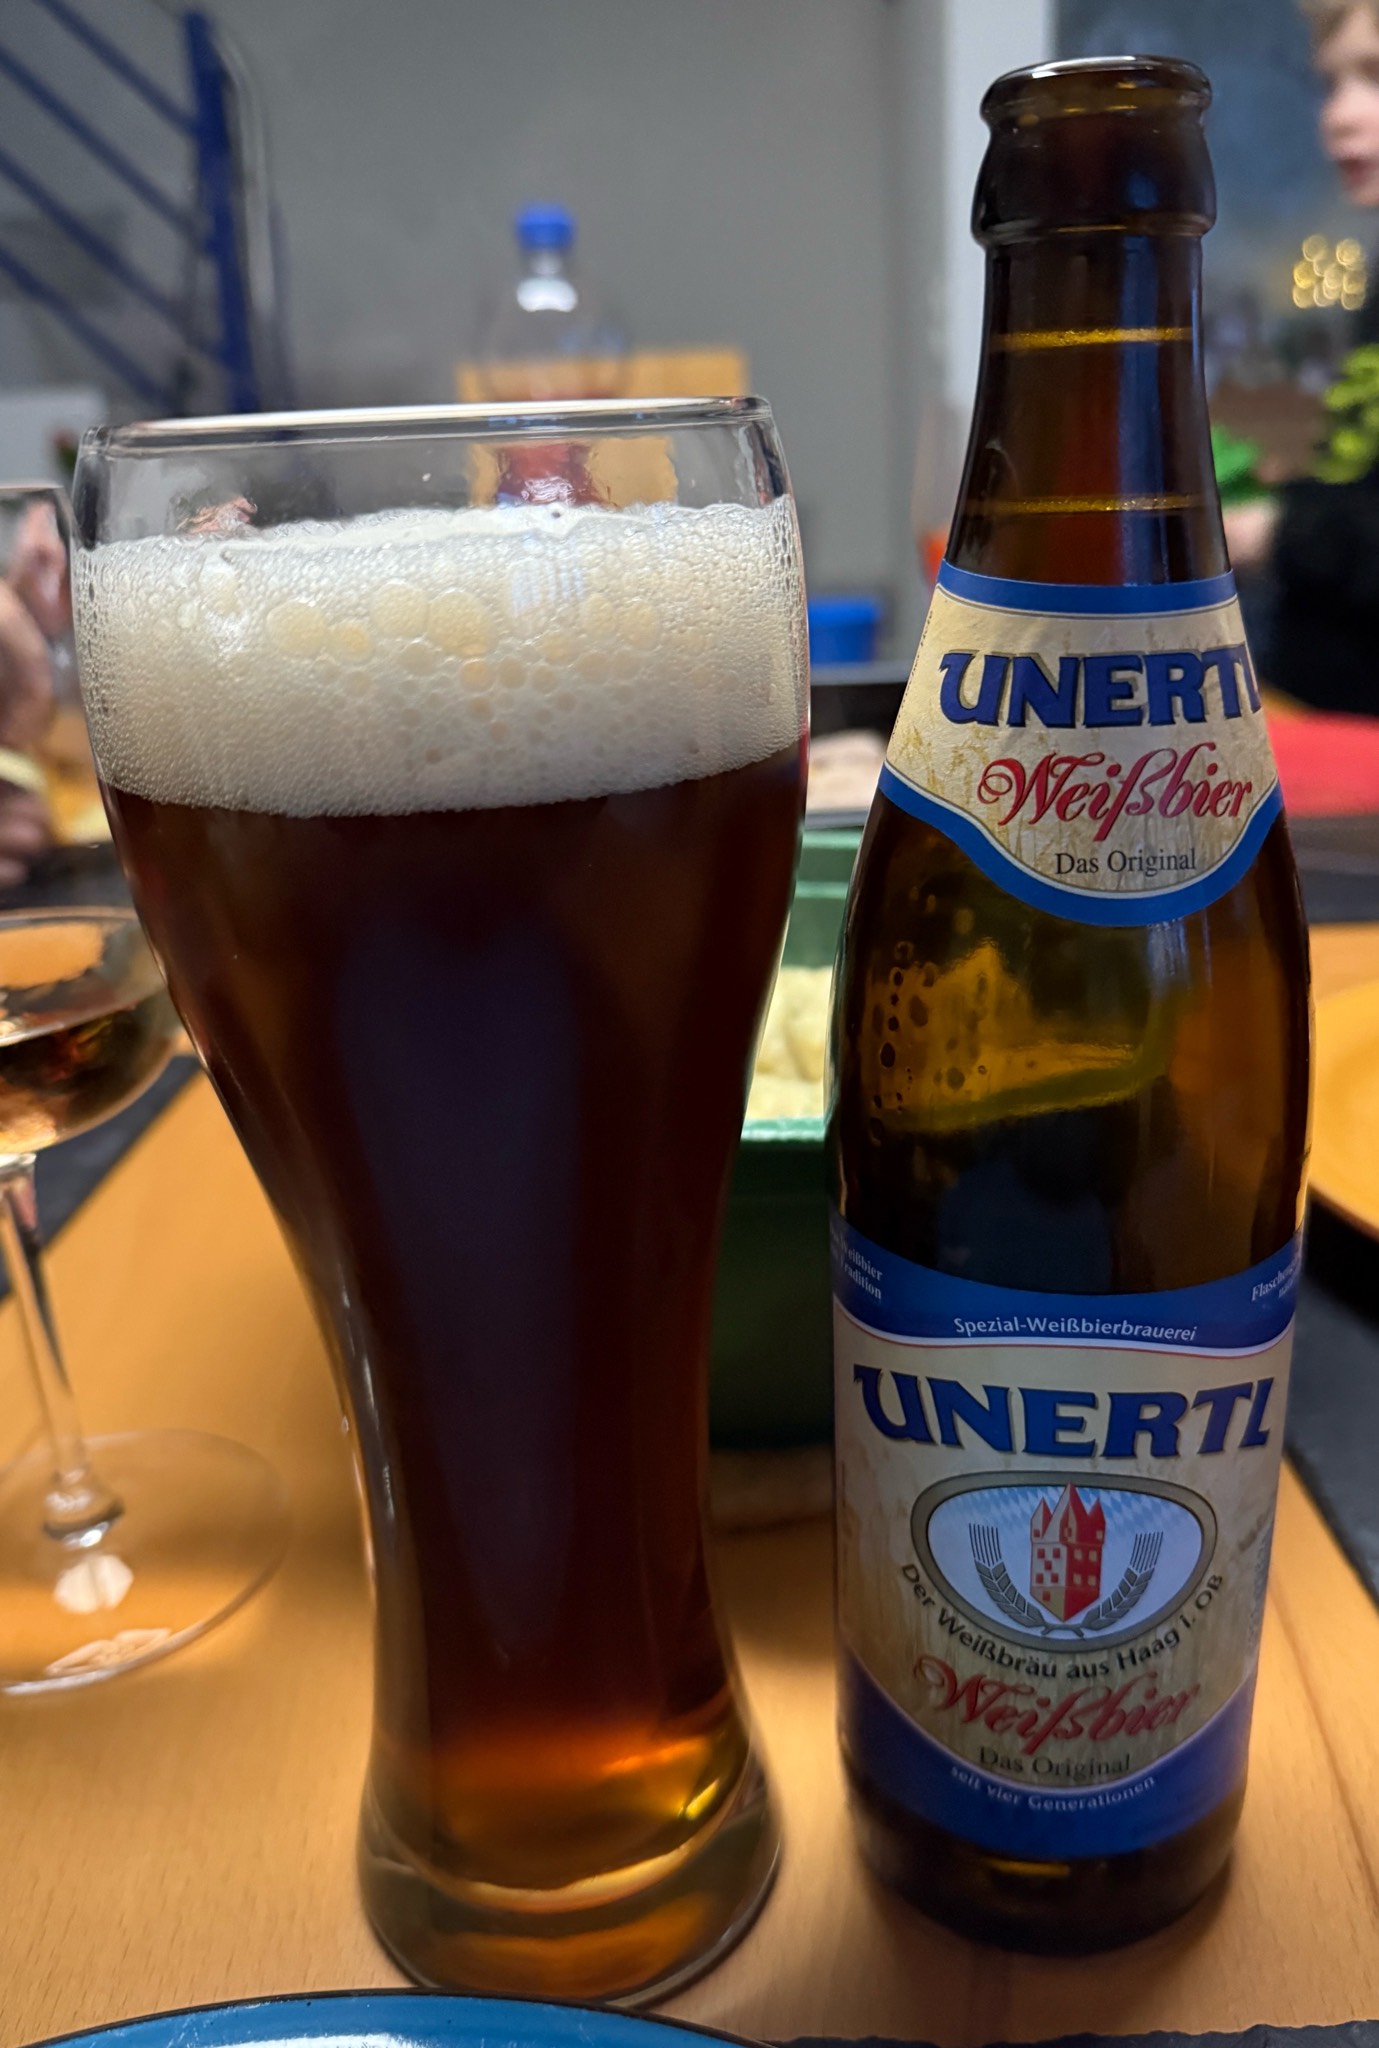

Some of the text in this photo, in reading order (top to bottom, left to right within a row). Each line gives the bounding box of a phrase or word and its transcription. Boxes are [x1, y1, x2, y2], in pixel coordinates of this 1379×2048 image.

[977, 742, 1252, 841] Weißbier
[1056, 848, 1197, 877] Das Original
[953, 1315, 1198, 1342] Spezial-Weißbierbrauerei
[852, 1363, 1275, 1459] UNERTL
[901, 1563, 1223, 1679] Der Weißbräu aus Haag i. OB
[912, 1653, 1201, 1756] Weißbier
[951, 1765, 1156, 1812] seit vier Generationen
[979, 1746, 1131, 1782] Das Original
